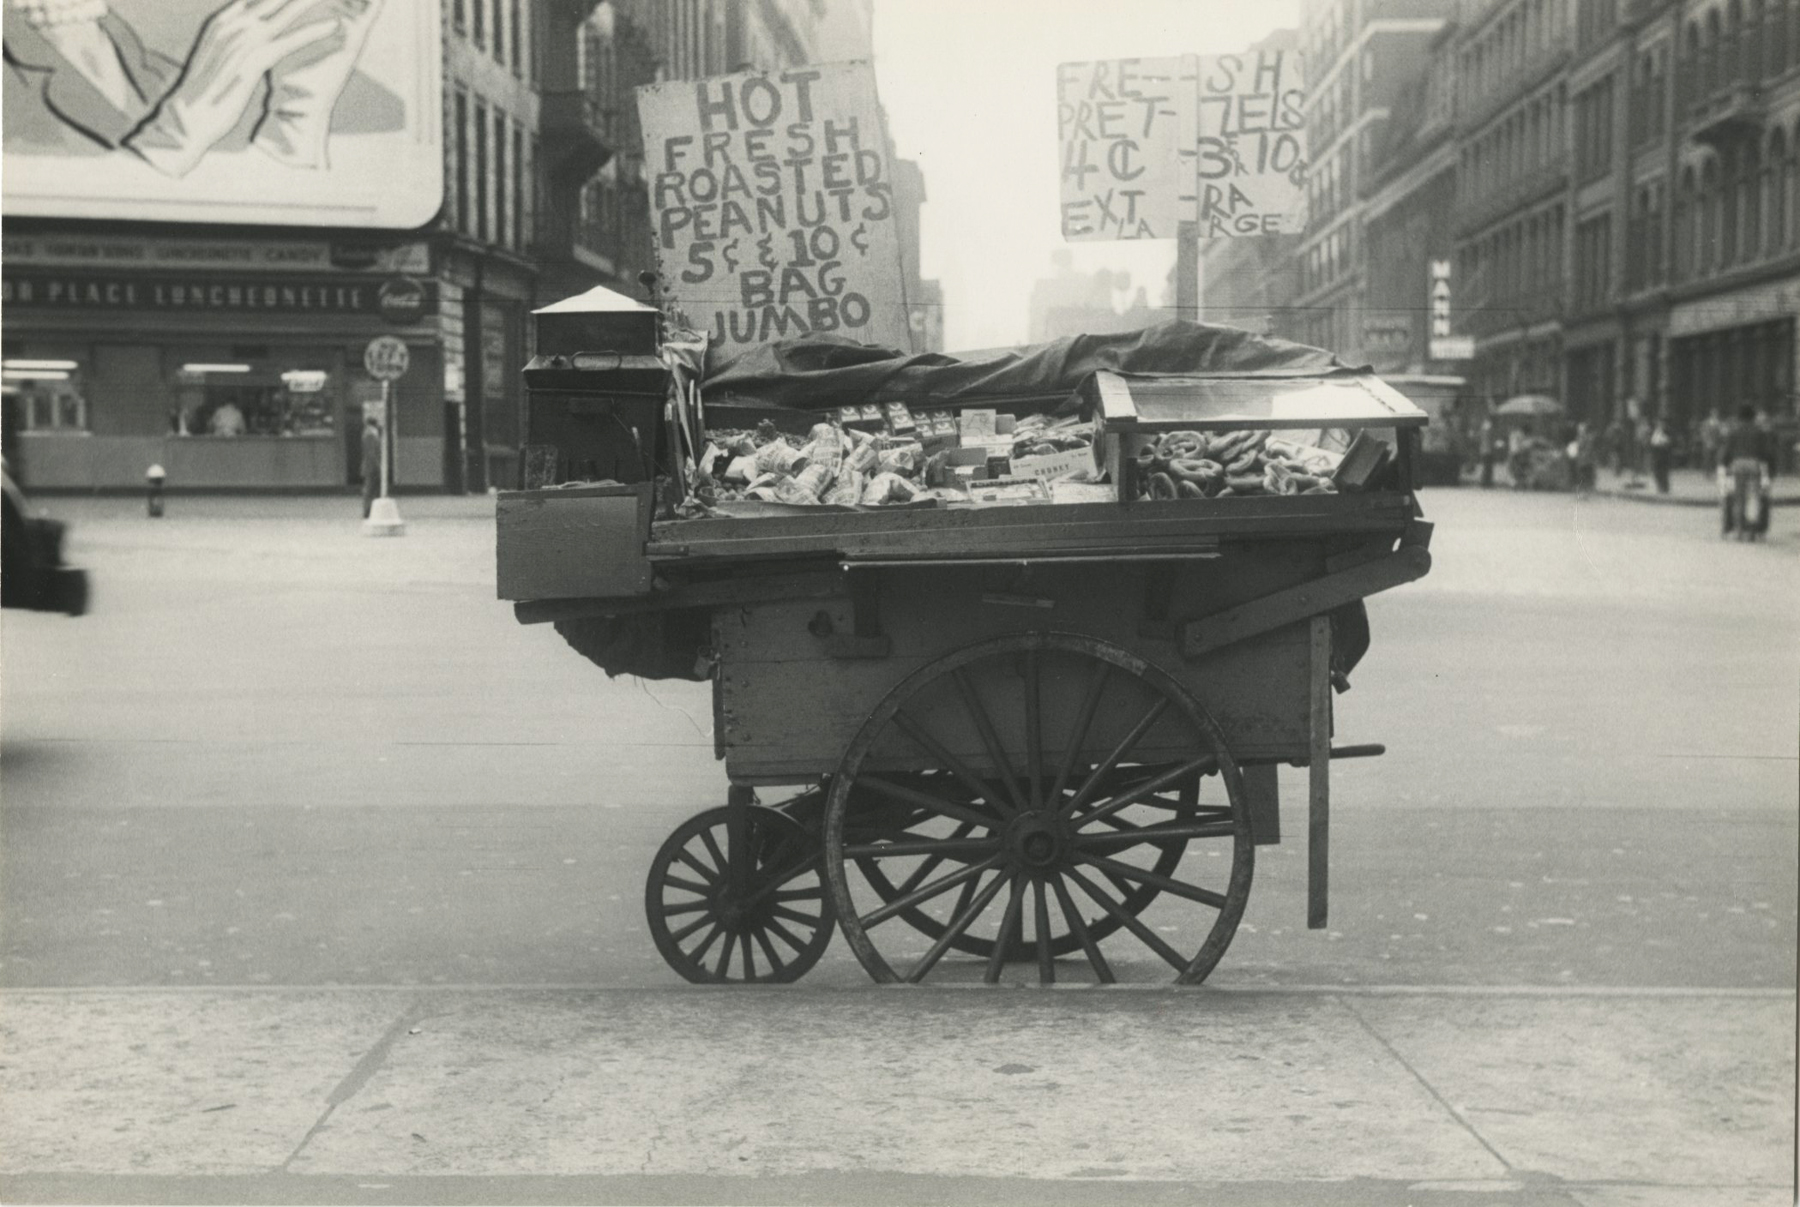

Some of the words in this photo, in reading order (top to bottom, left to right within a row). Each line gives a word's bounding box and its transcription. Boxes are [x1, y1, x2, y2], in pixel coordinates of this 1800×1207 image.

[697, 70, 821, 131] HOT
[664, 116, 861, 171] FRESH
[654, 149, 881, 210] ROASTED
[660, 182, 892, 249] PEANUTS
[739, 260, 846, 308] BAG
[707, 292, 871, 348] JUMBO
